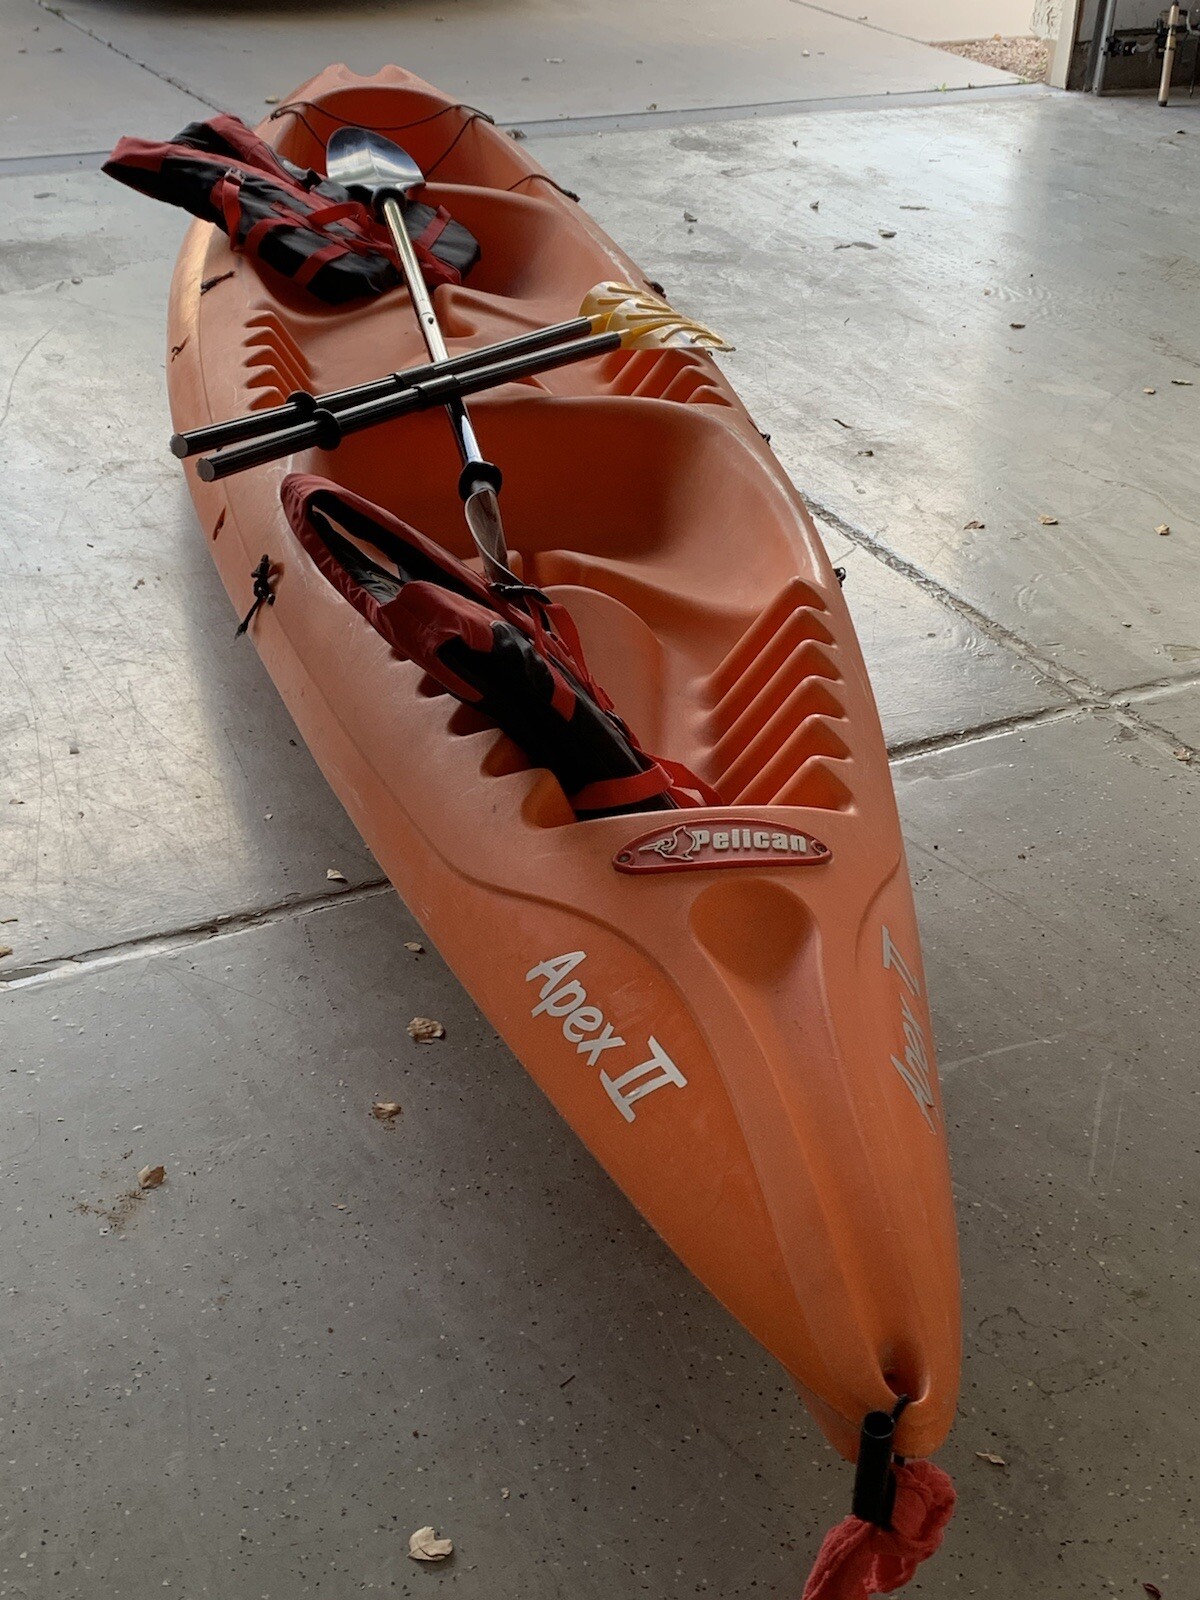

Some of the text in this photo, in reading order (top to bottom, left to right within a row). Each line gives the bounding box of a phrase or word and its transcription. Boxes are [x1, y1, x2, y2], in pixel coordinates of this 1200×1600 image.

[691, 828, 807, 853] Pelican
[525, 951, 688, 1123] Apex II
